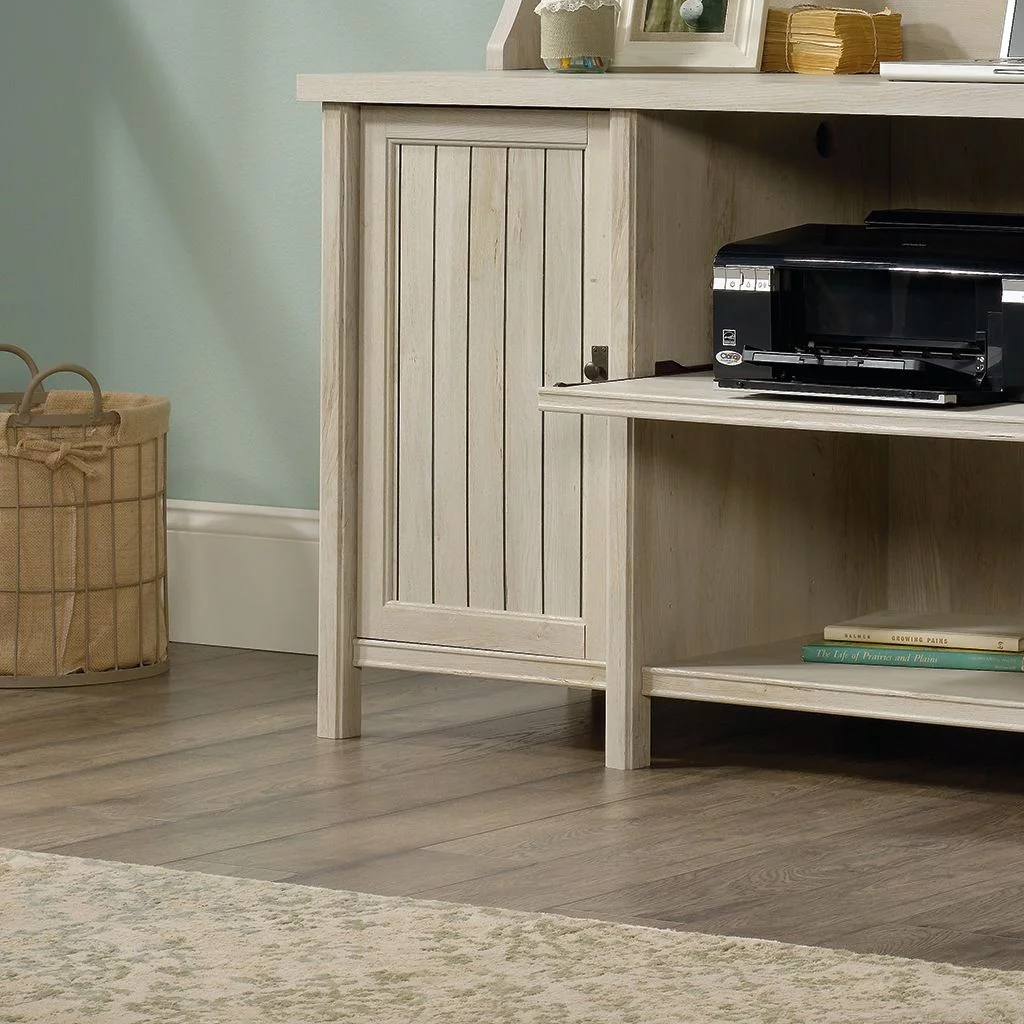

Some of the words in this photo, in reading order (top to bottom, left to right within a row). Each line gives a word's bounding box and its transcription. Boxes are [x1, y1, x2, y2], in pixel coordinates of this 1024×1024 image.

[891, 635, 923, 643] GROWING
[816, 648, 830, 657] The
[833, 649, 848, 662] Life
[851, 651, 860, 662] of
[862, 650, 893, 661] Prairies
[894, 653, 911, 662] and
[913, 653, 938, 663] Plains
